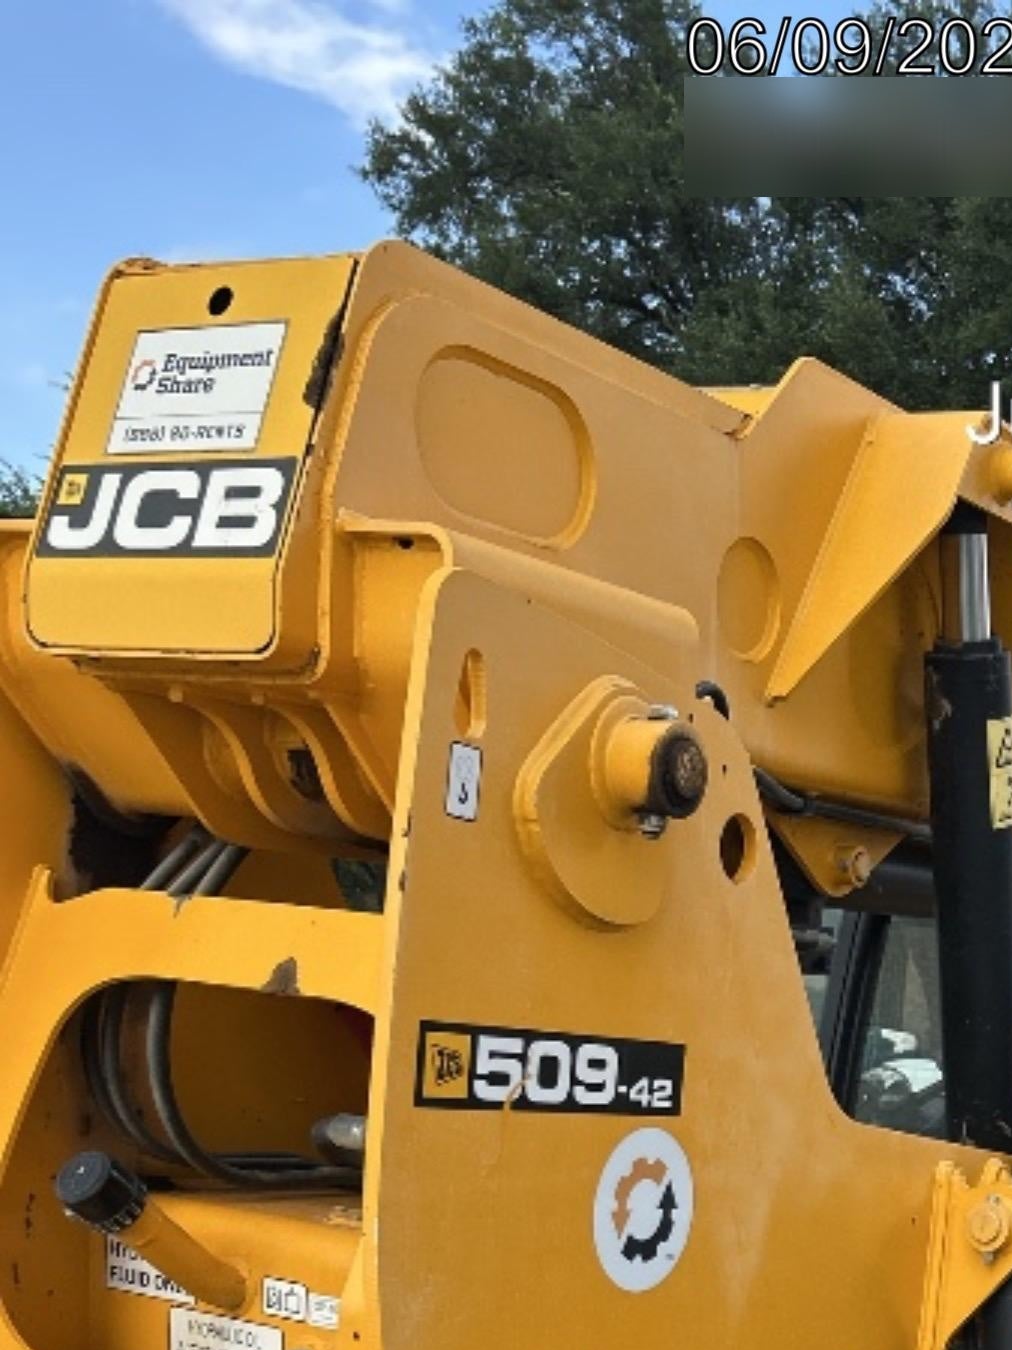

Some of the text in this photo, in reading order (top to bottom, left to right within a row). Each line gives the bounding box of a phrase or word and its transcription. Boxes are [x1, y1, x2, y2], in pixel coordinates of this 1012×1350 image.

[155, 375, 216, 394] Share
[161, 349, 274, 375] Equipment
[47, 467, 286, 550] JCB
[473, 1034, 673, 1108] 509-42
